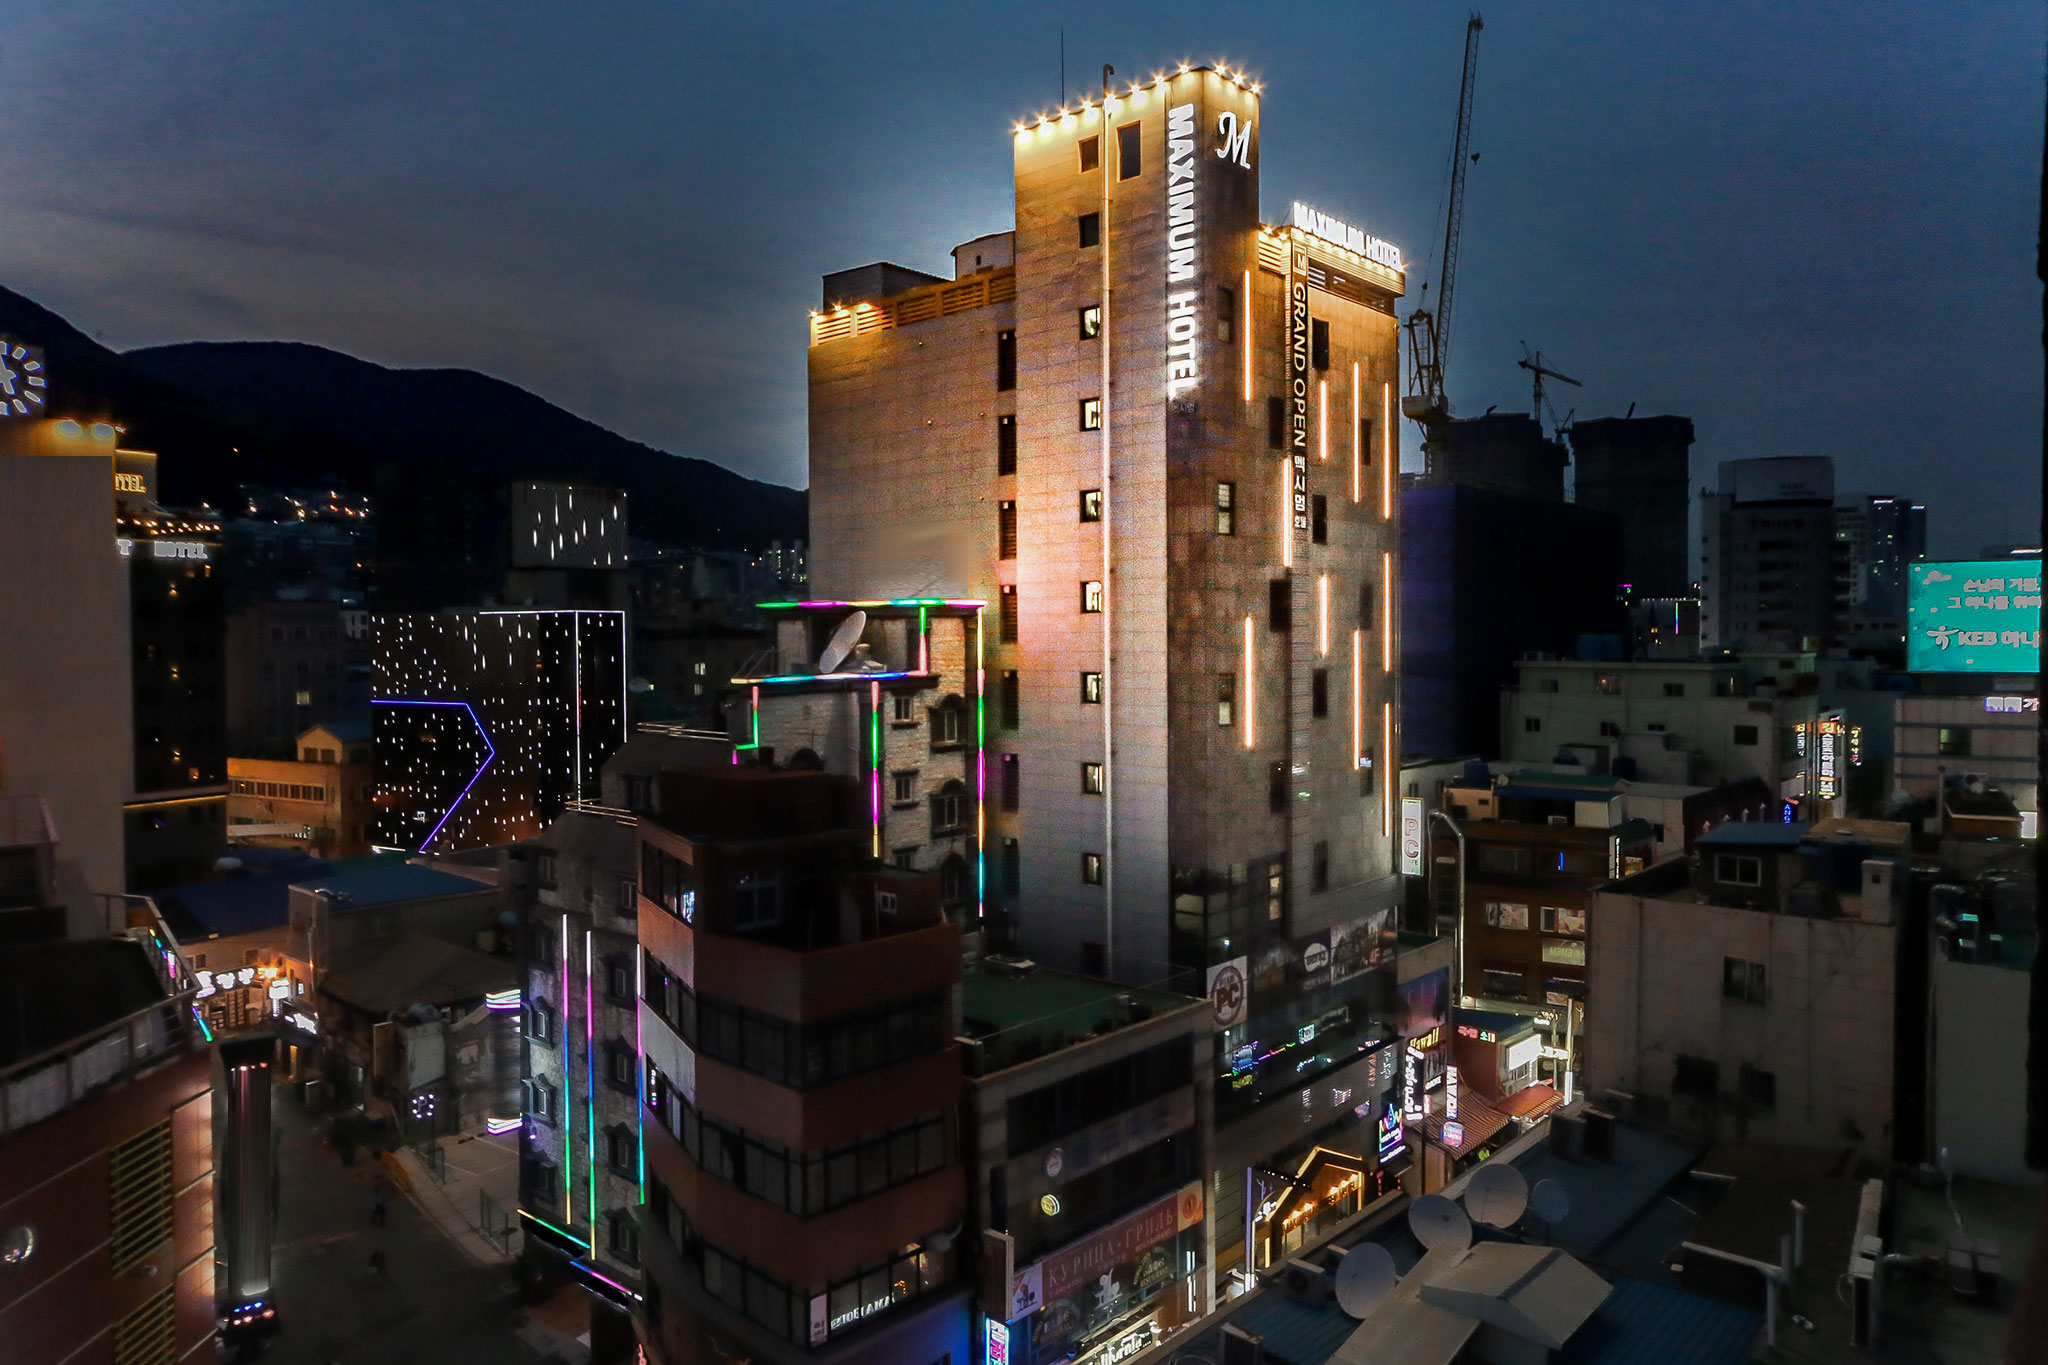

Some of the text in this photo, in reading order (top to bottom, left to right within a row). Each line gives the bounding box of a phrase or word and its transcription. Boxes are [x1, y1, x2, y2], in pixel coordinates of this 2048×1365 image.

[1217, 111, 1252, 170] M
[1168, 103, 1196, 398] MAXIMUM HOTEL
[1294, 201, 1403, 272] MAXIMUM HOTEL
[1293, 282, 1306, 447] GRAND OPEN
[154, 541, 208, 558] HOTEL
[1958, 631, 1998, 646] KEB
[1404, 818, 1419, 858] PC
[1217, 983, 1240, 1014] PC
